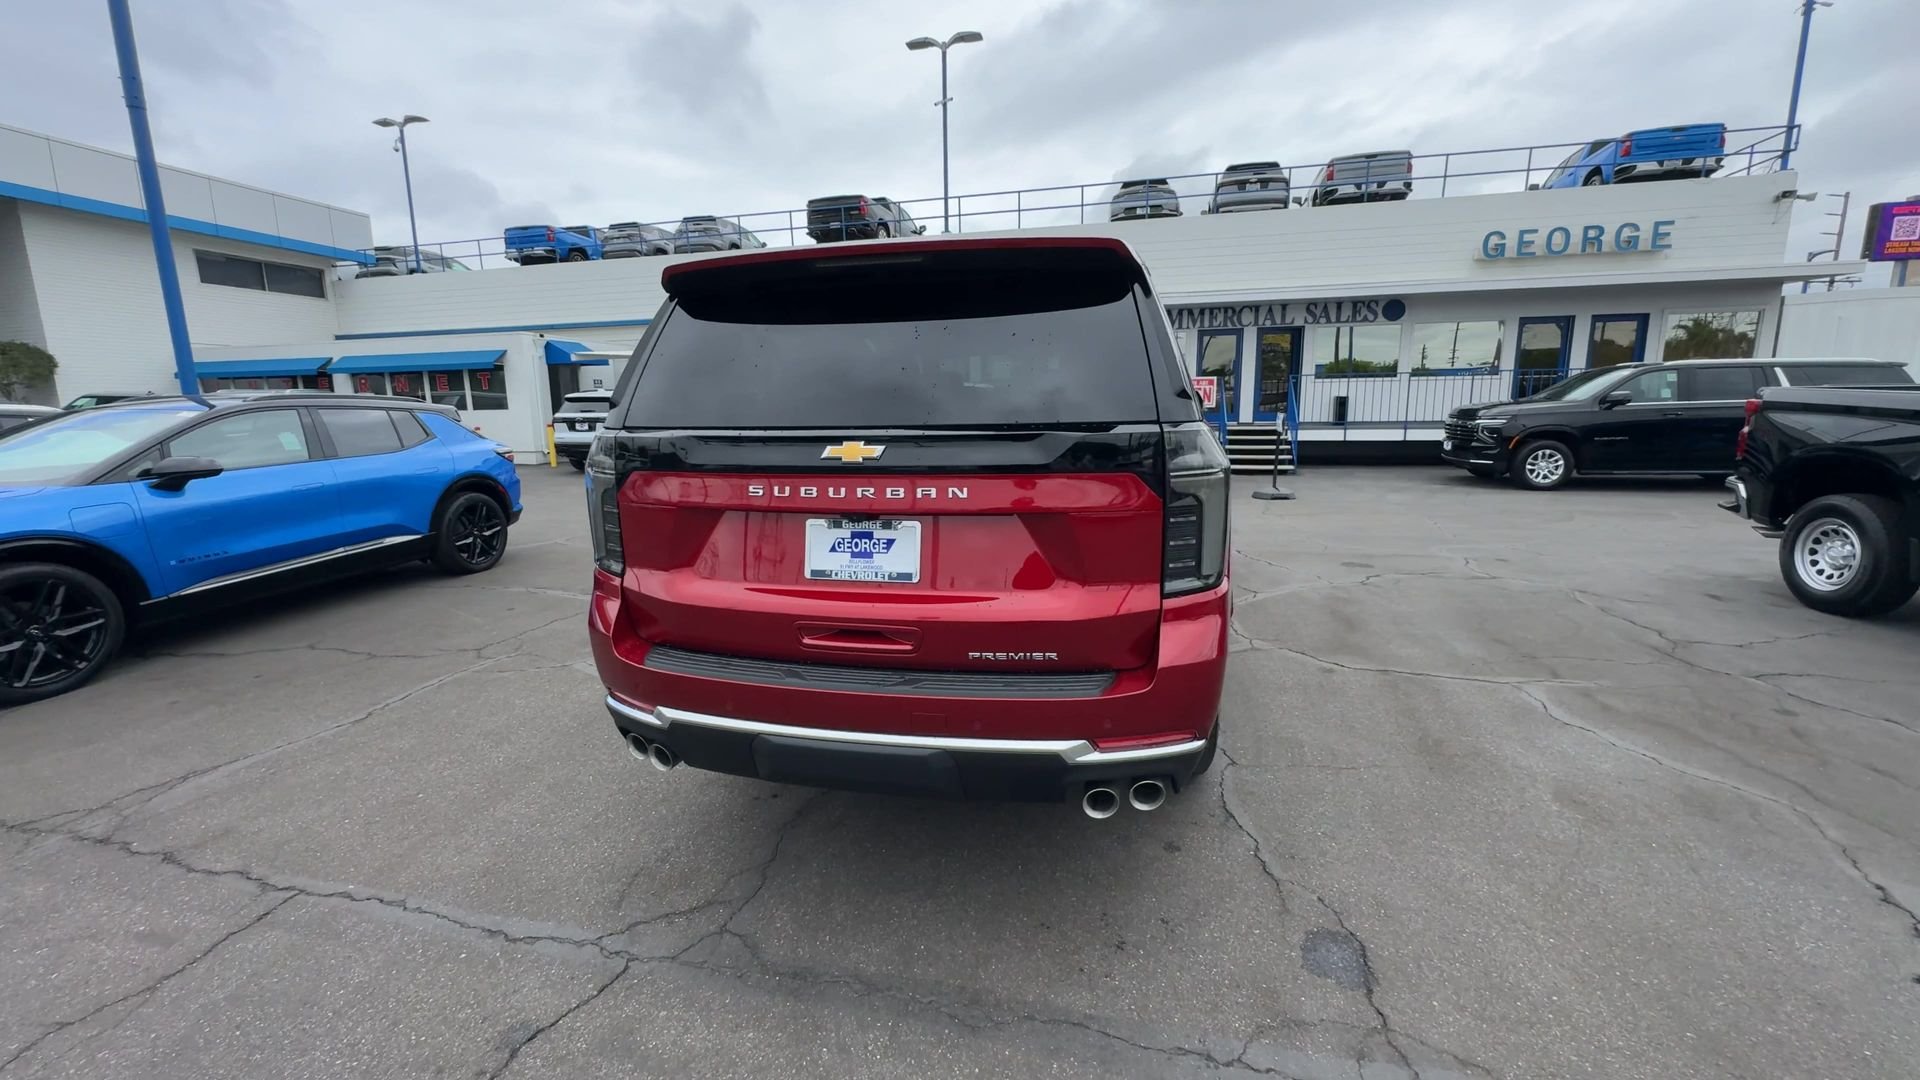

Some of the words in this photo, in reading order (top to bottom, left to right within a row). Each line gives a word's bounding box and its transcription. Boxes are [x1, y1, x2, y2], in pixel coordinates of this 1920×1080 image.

[1482, 220, 1675, 259] GEORGE
[1166, 303, 1295, 330] MMERCIAL
[1303, 300, 1379, 324] SALES
[748, 485, 968, 499] SUBURBAN
[842, 520, 883, 530] GEORGE
[834, 538, 888, 553] GEORGE
[832, 570, 890, 581] CHEVROLET
[968, 652, 1058, 660] PREMIER
